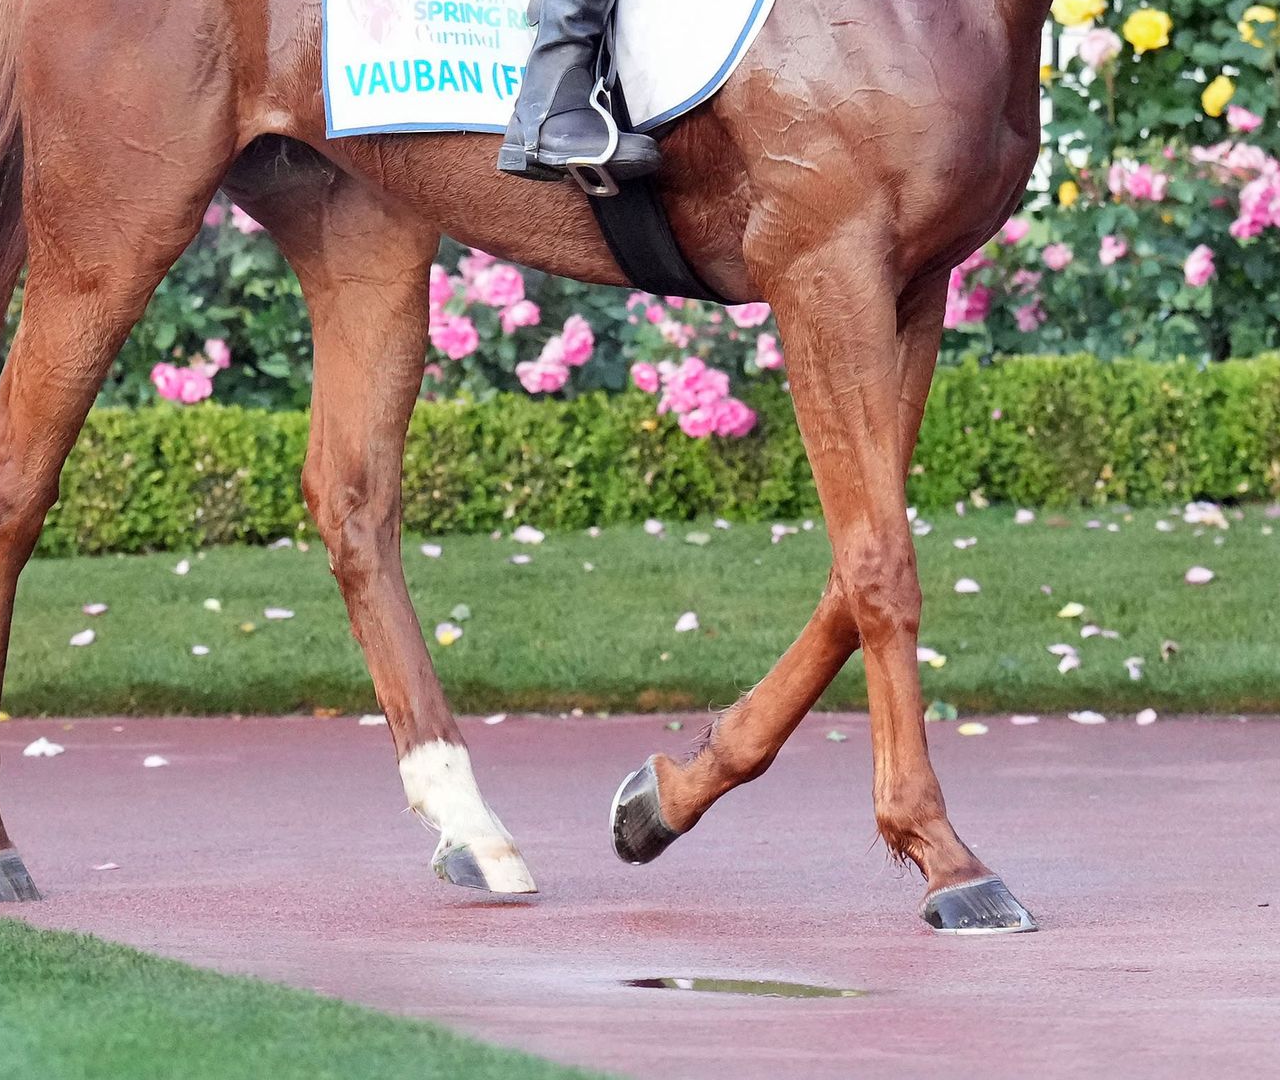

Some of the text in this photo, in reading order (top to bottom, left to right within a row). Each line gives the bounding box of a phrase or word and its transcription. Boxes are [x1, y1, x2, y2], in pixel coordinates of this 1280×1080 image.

[414, 1, 501, 27] SPRING
[415, 24, 501, 49] Carnival
[345, 59, 526, 100] VAUBAN (F
